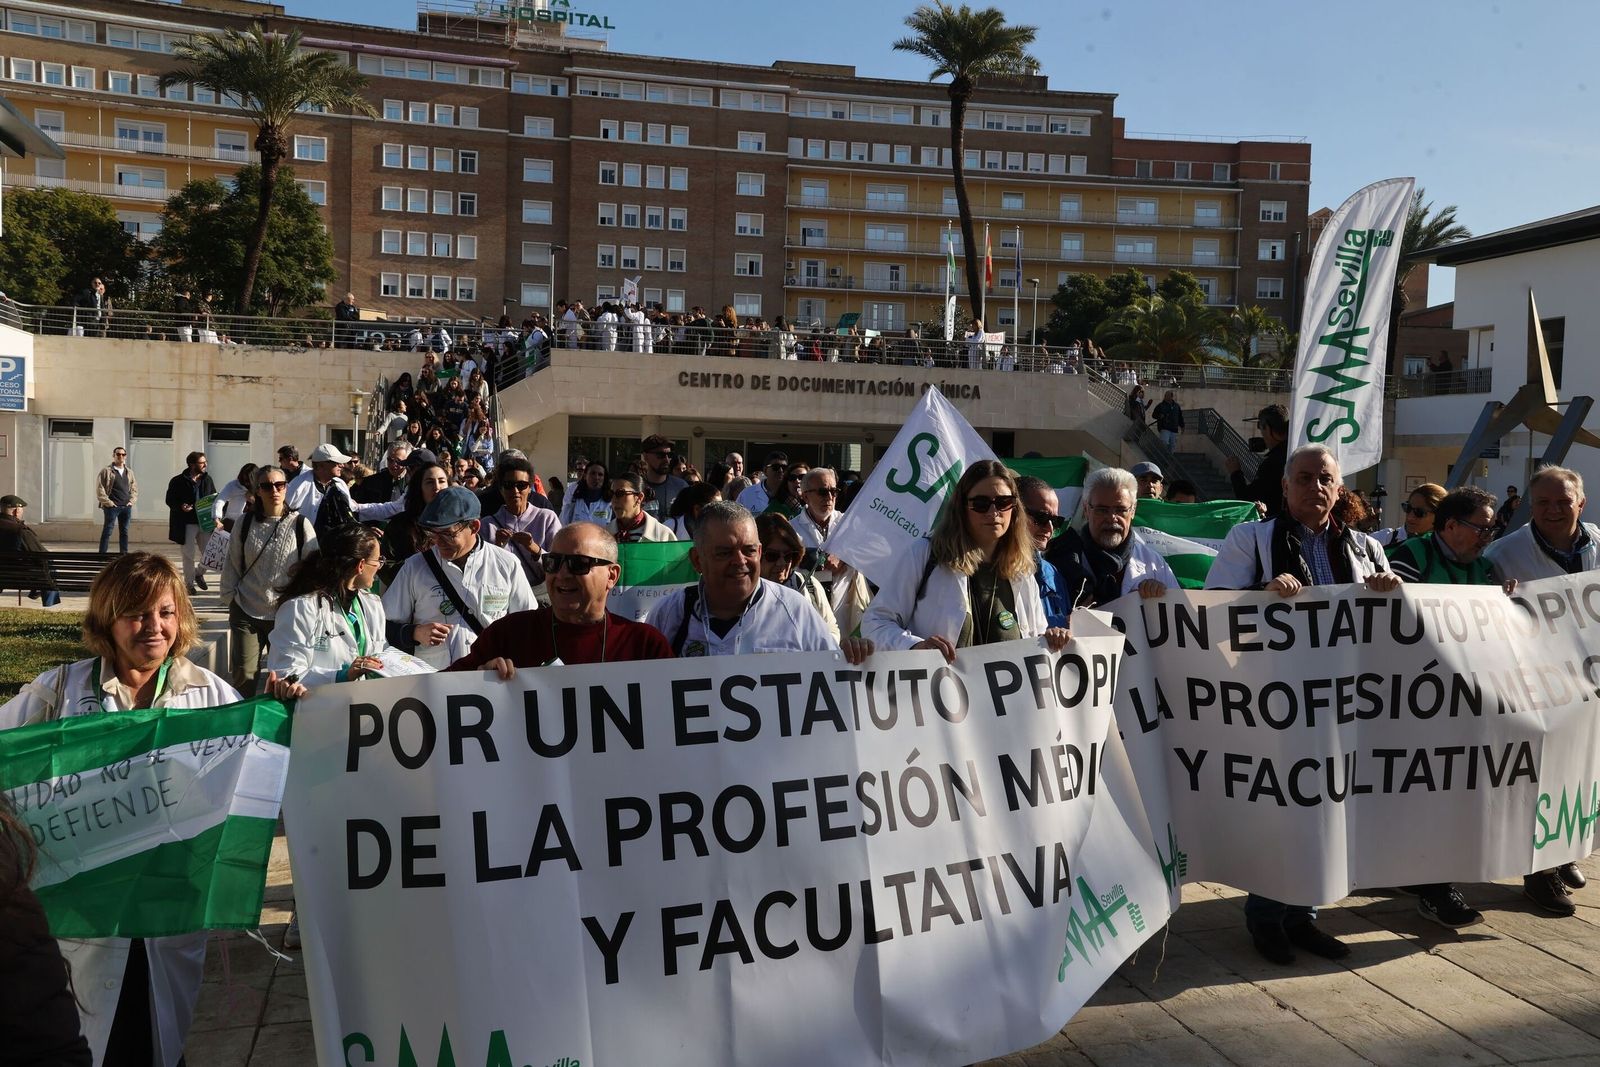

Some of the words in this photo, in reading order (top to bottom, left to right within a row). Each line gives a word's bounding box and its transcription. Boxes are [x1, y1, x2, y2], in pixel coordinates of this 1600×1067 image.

[500, 4, 616, 30] HOSPITAL
[1327, 229, 1368, 328] Sevilla
[677, 371, 745, 390] CENTRO
[751, 374, 771, 391] DE
[777, 376, 915, 397] DOCUMENTACIÓN
[920, 379, 981, 400] CÍNICA
[869, 497, 920, 538] Sindicato
[1140, 602, 1209, 650] UN
[1228, 597, 1468, 651] ESTATUTO
[346, 694, 500, 772] POR
[523, 683, 645, 758] UN
[671, 666, 969, 742] ESTATUTO
[1129, 677, 1174, 734] LA
[1187, 658, 1482, 730] PROFESIÓN
[100, 759, 131, 784] NO
[145, 748, 166, 768] SE
[189, 732, 268, 757] VENDE
[1173, 747, 1208, 791] Y
[1224, 741, 1538, 807] FACULTATIVA
[28, 777, 178, 848] DEFIENDE
[346, 815, 446, 890] DE
[472, 803, 583, 883] LA
[604, 747, 987, 867] PROFESIÓN
[997, 729, 1106, 812] MÉDI
[581, 911, 636, 985] Y
[661, 842, 1072, 976] FACULTATIVA
[1100, 883, 1126, 908] Sevilla
